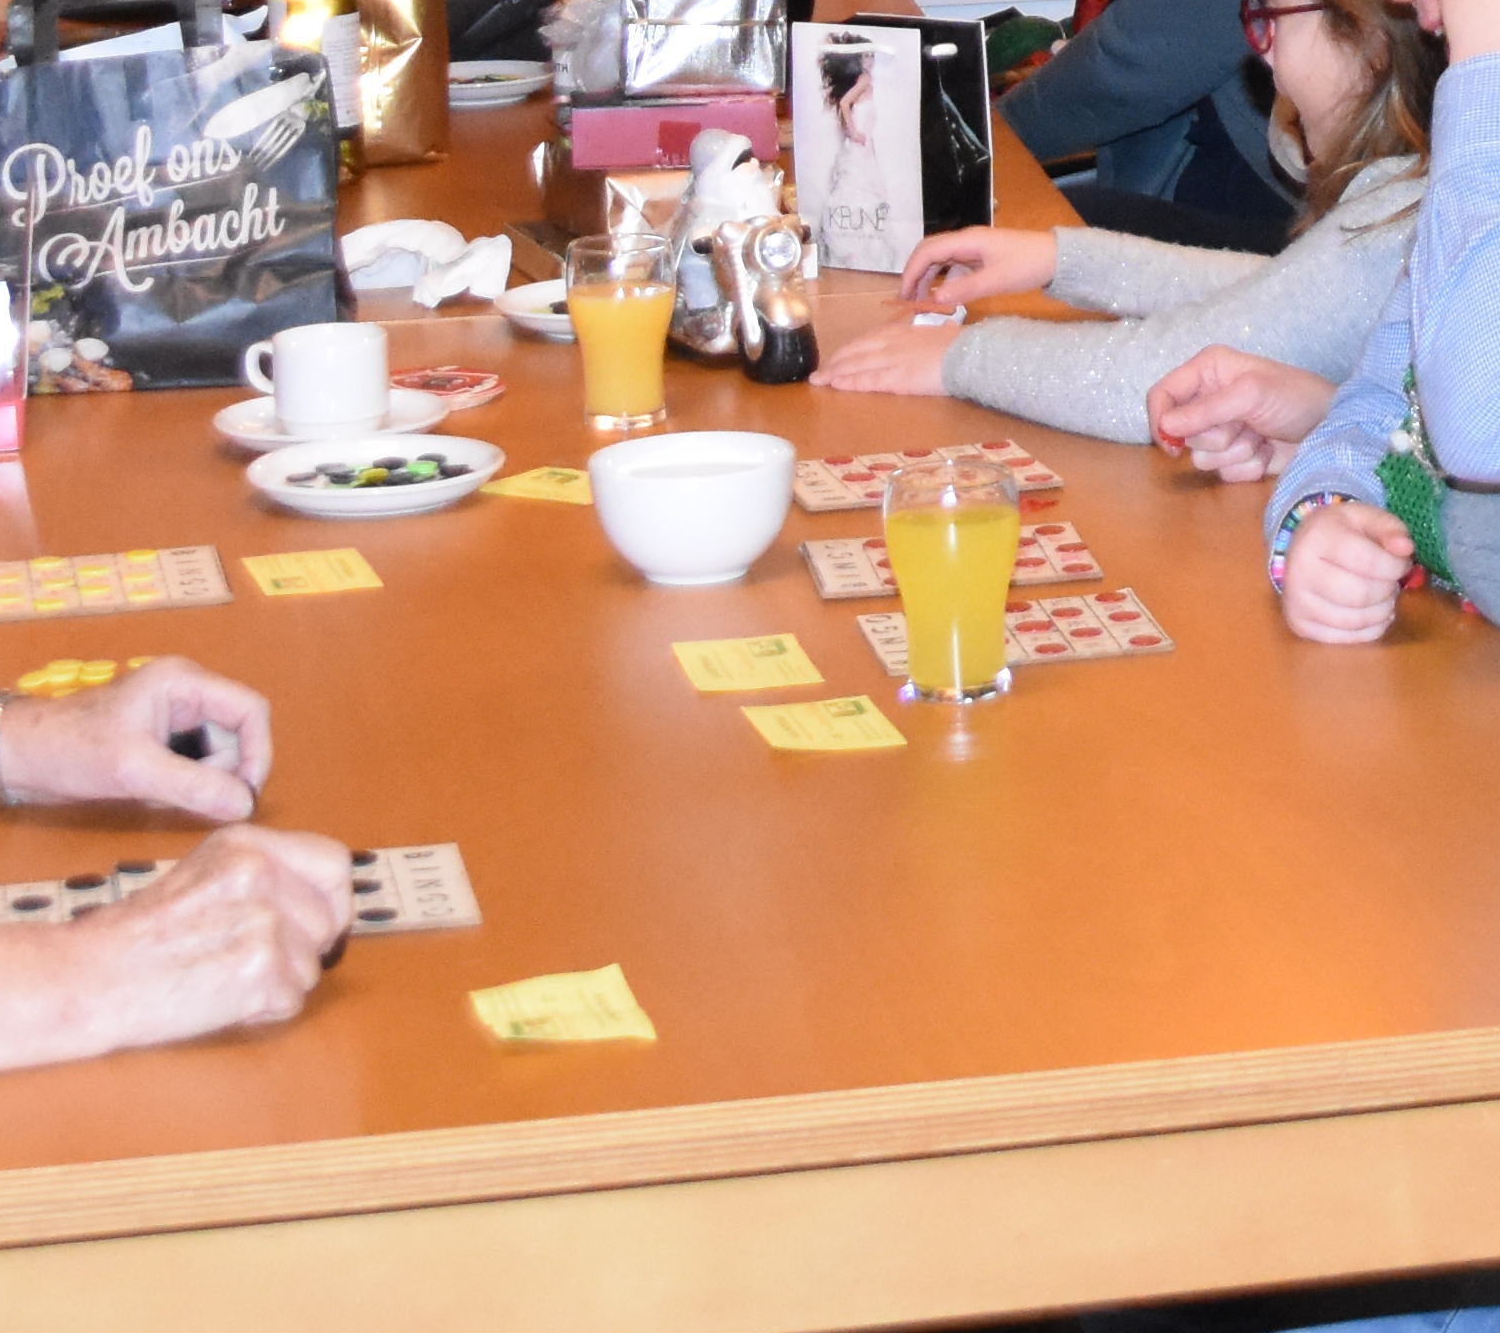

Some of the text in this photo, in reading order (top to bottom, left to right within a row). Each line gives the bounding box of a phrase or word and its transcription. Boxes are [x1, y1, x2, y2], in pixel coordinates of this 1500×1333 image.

[2, 124, 242, 227] Proef ons
[38, 181, 286, 293] Ambacht
